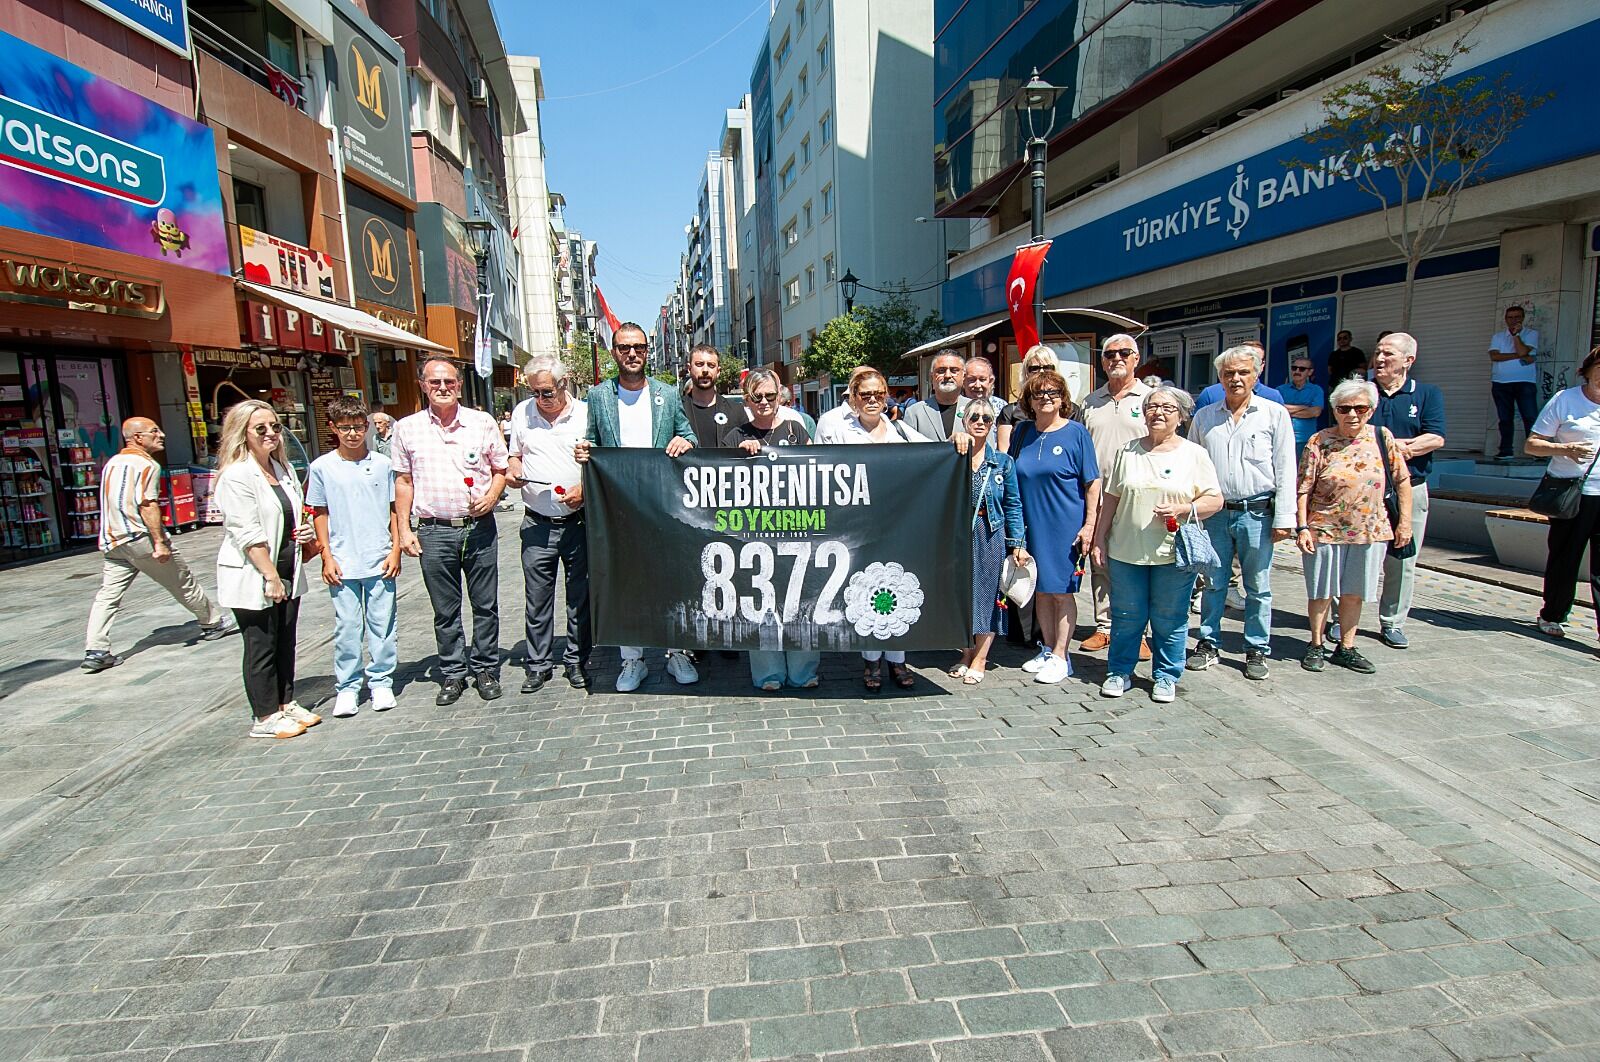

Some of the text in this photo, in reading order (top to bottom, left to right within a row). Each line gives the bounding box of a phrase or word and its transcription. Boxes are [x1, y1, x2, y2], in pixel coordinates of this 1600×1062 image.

[130, 0, 173, 24] ANCH
[352, 44, 386, 120] M
[0, 114, 141, 188] atsons
[1122, 196, 1221, 250] TÜRKİYE
[1257, 125, 1422, 208] BANKASI
[2, 259, 147, 304] watsons
[367, 229, 396, 283] M
[682, 458, 871, 508] SREBRENİTSA
[714, 508, 827, 532] SOYKIRIMI
[701, 541, 851, 625] 8372
